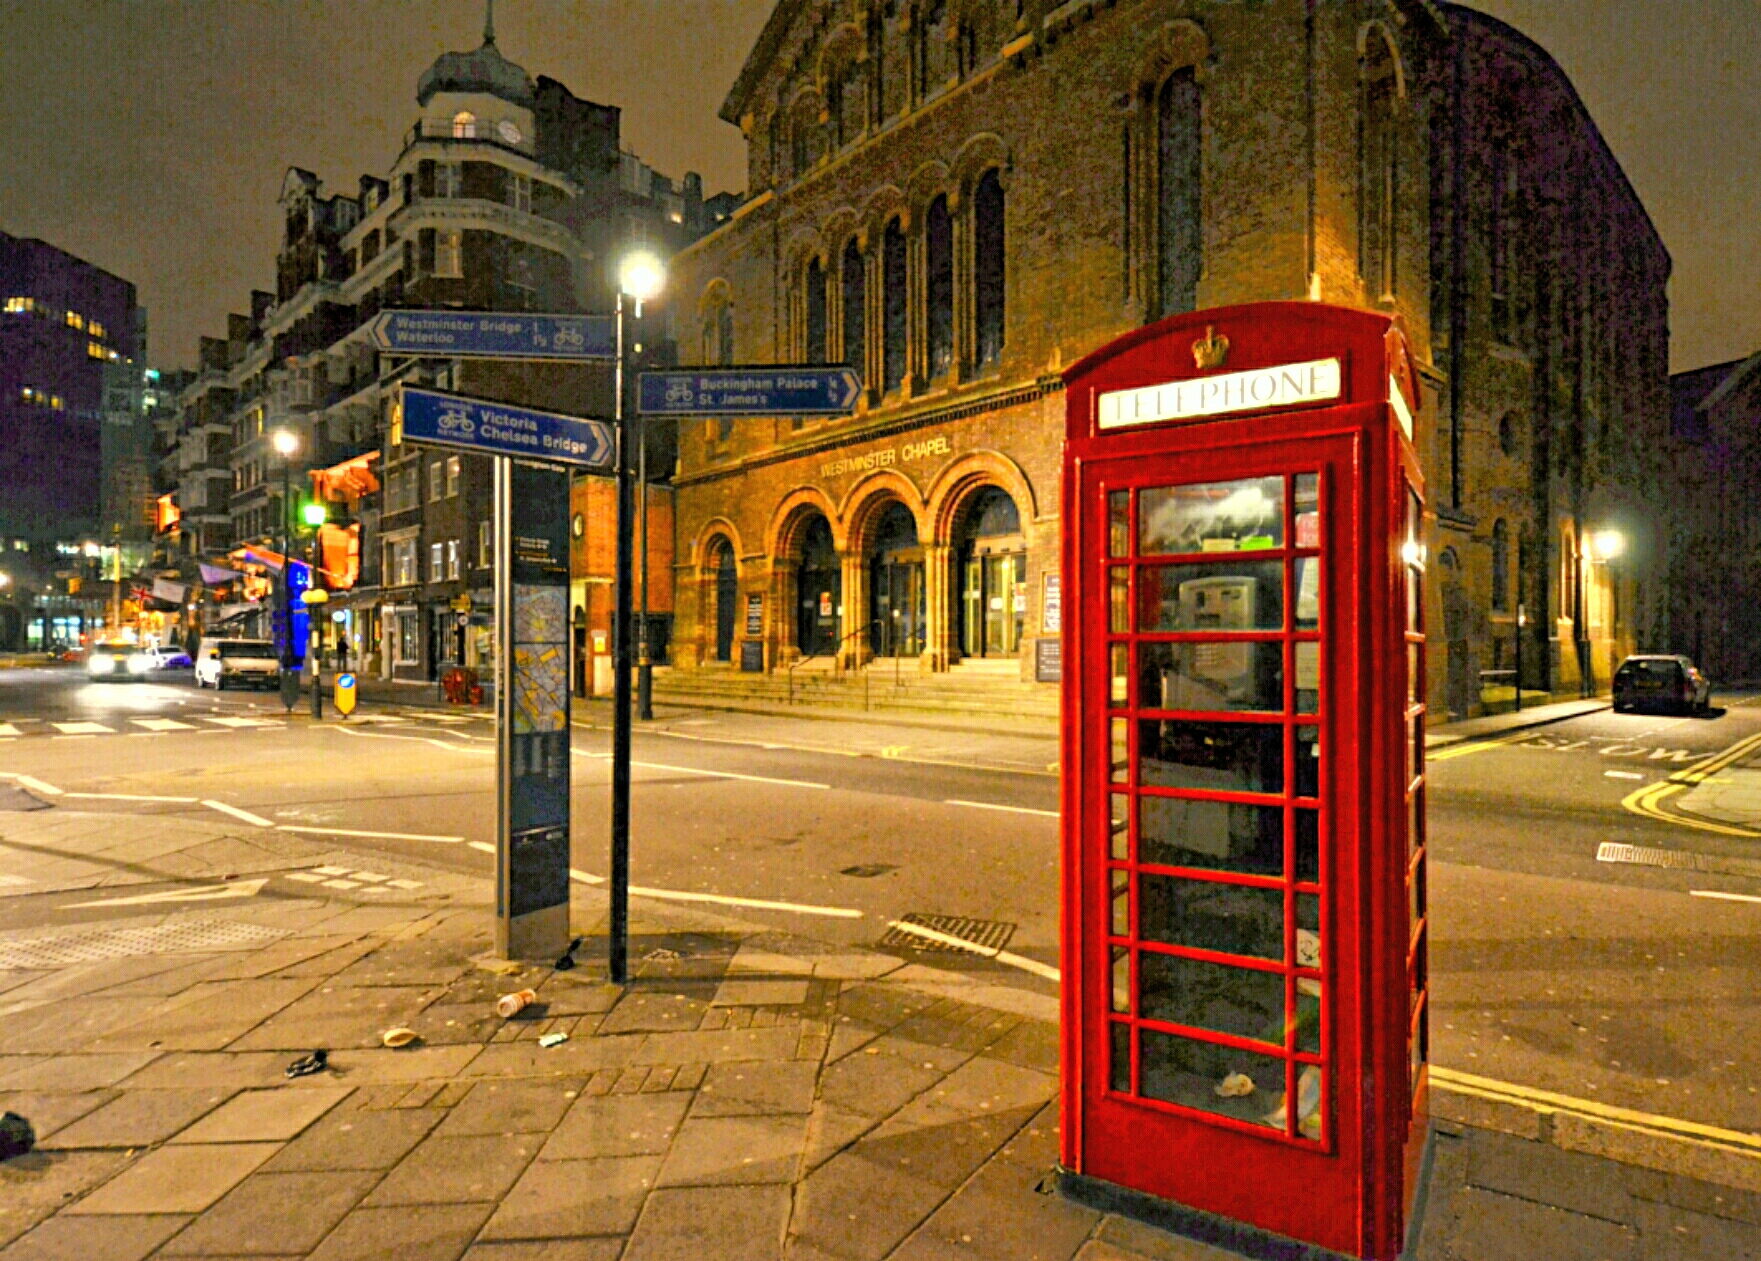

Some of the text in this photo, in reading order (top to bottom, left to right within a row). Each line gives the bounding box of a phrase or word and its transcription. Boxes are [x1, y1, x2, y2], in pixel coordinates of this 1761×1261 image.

[396, 317, 474, 331] Westminster
[480, 320, 522, 334] Bridge
[396, 331, 455, 343] Waterloo
[700, 376, 773, 392] Buckingham
[777, 376, 818, 389] Palace
[1107, 363, 1329, 420] TELEPHONE
[480, 409, 538, 432] Victoria
[480, 424, 588, 455] Chelsea Bridge
[820, 436, 951, 478] WESTMINSTER CHAPEL
